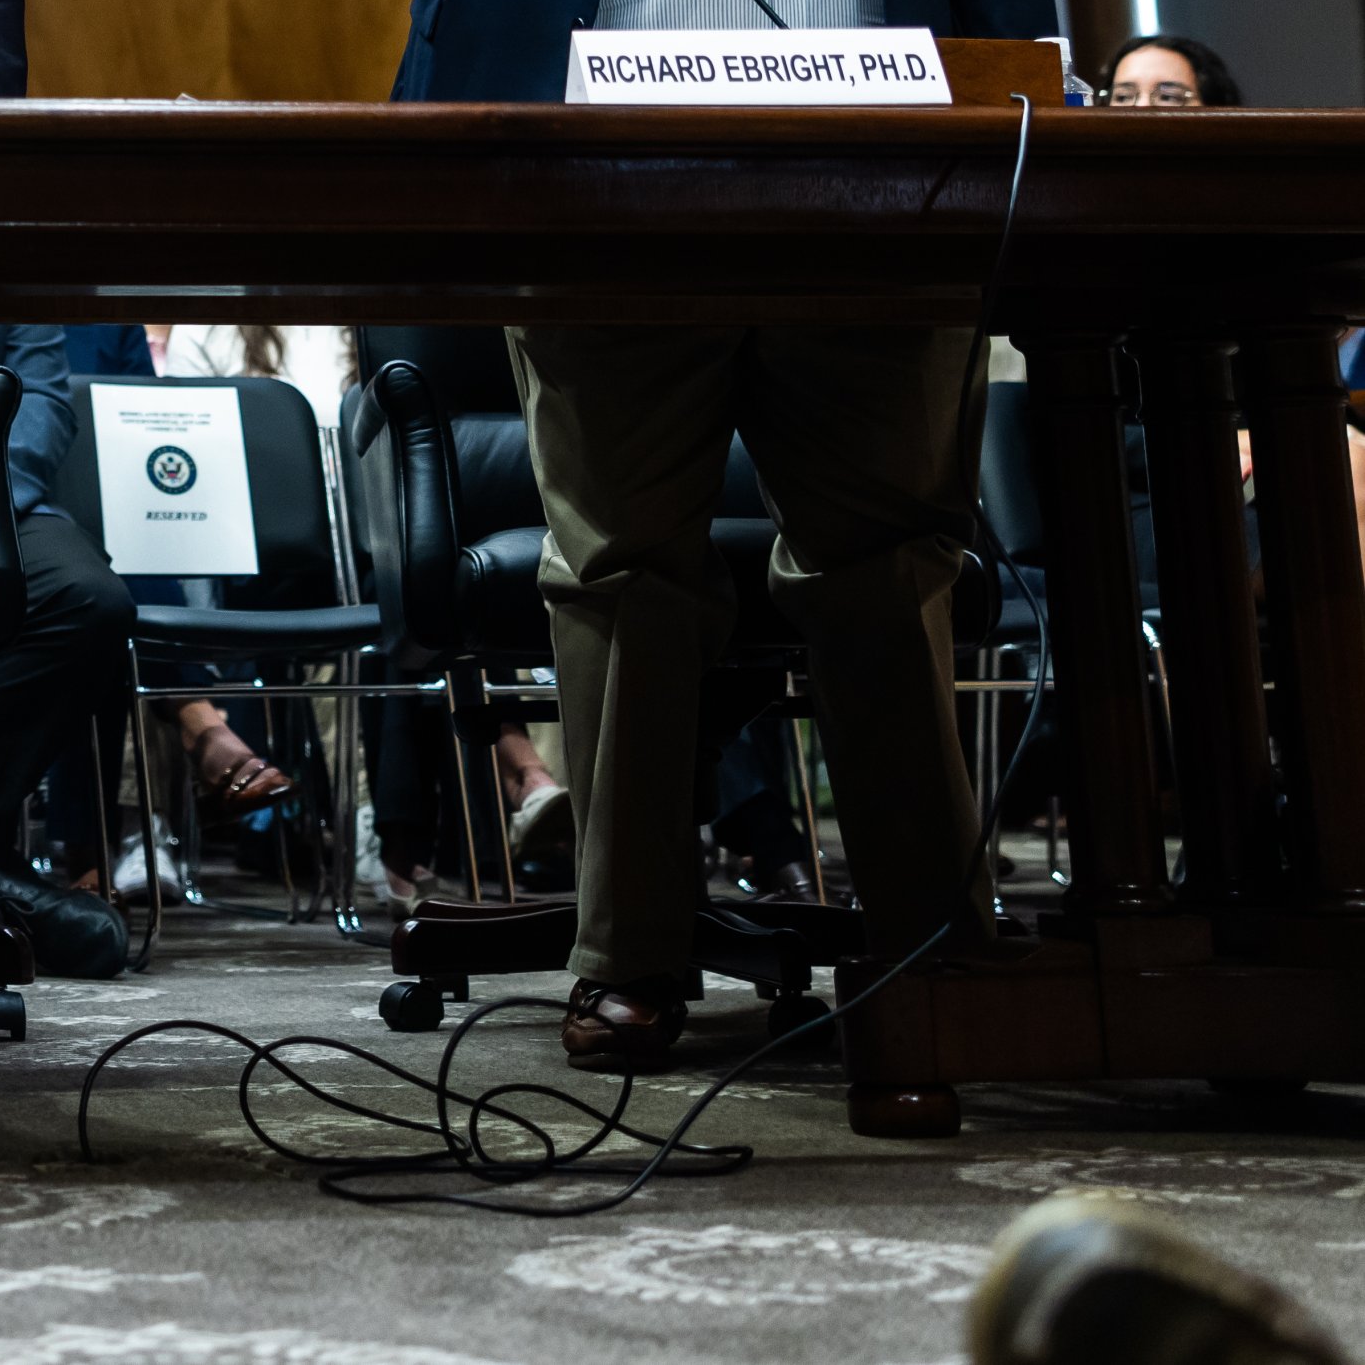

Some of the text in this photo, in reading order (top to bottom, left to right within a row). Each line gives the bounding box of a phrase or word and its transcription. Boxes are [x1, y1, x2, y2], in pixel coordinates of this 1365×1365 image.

[587, 53, 937, 87] RICHARD EBRIGHT, PH.D.
[145, 510, 208, 522] RESERVED
